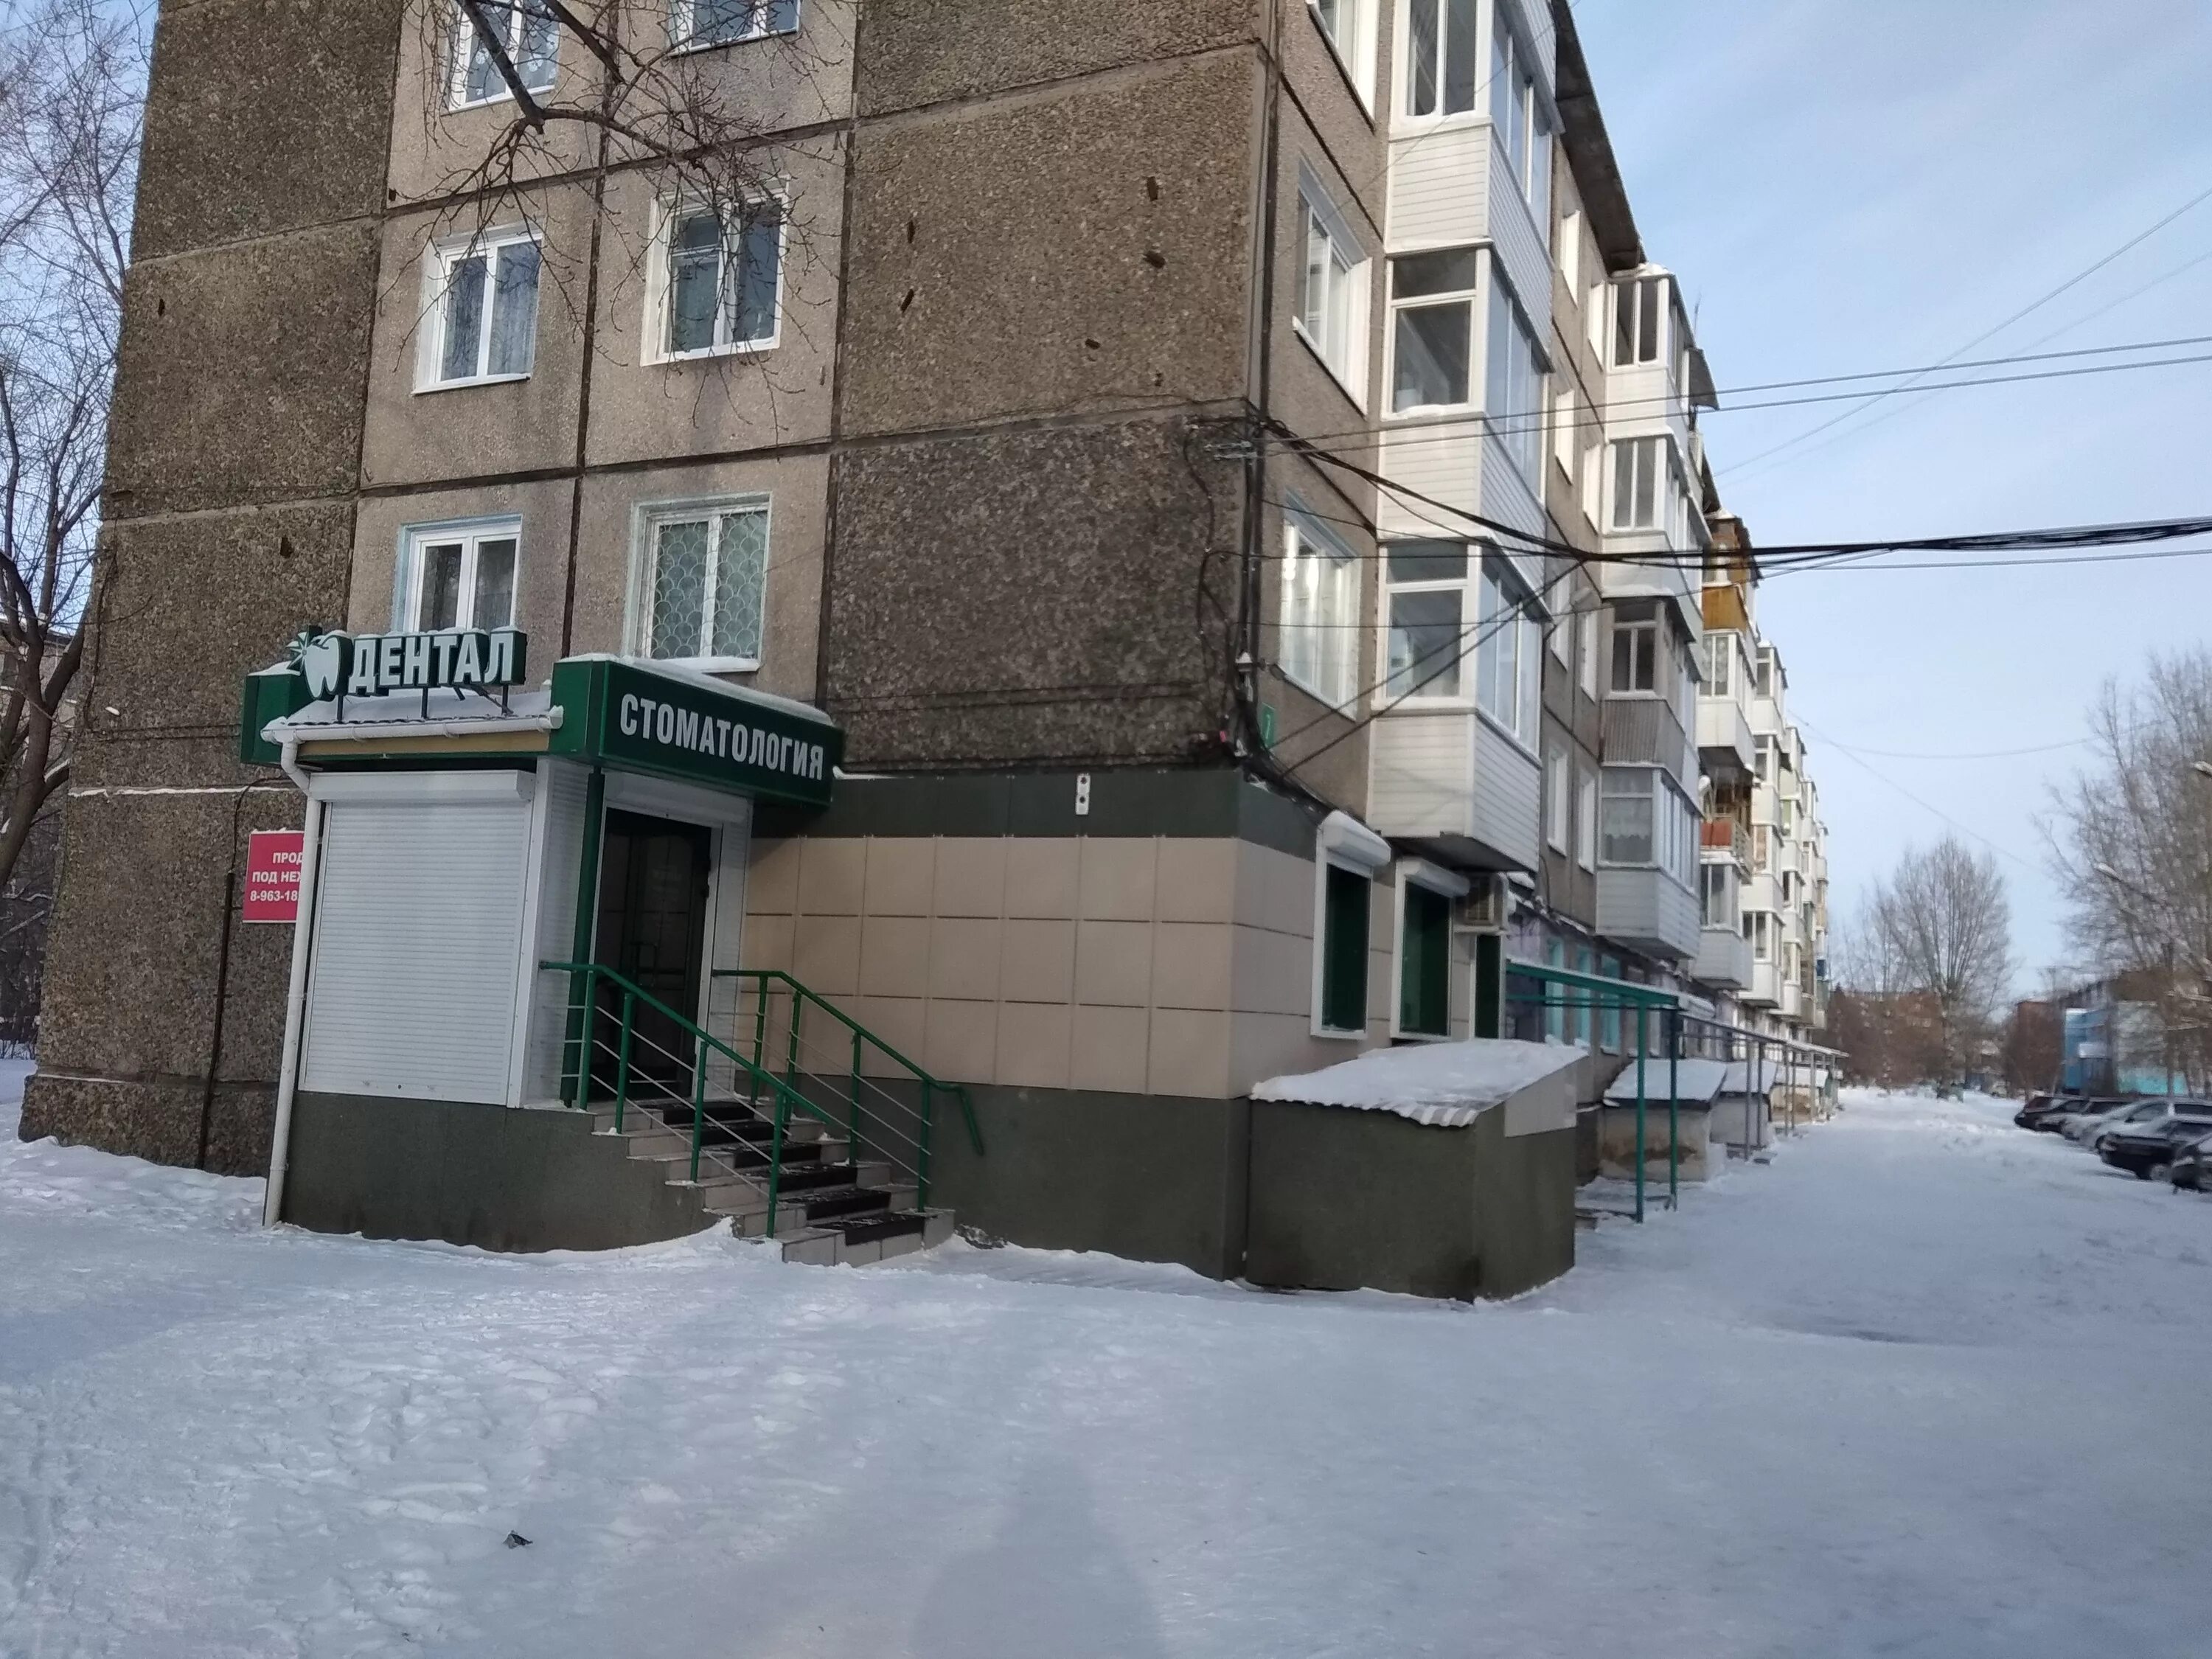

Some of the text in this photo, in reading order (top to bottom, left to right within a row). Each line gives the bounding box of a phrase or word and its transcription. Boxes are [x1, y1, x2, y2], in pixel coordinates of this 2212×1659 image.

[349, 632, 515, 695] ДЕНТАЛ
[620, 694, 824, 781] СТОМАТОЛОГИЯ
[252, 872, 277, 884] ПОД
